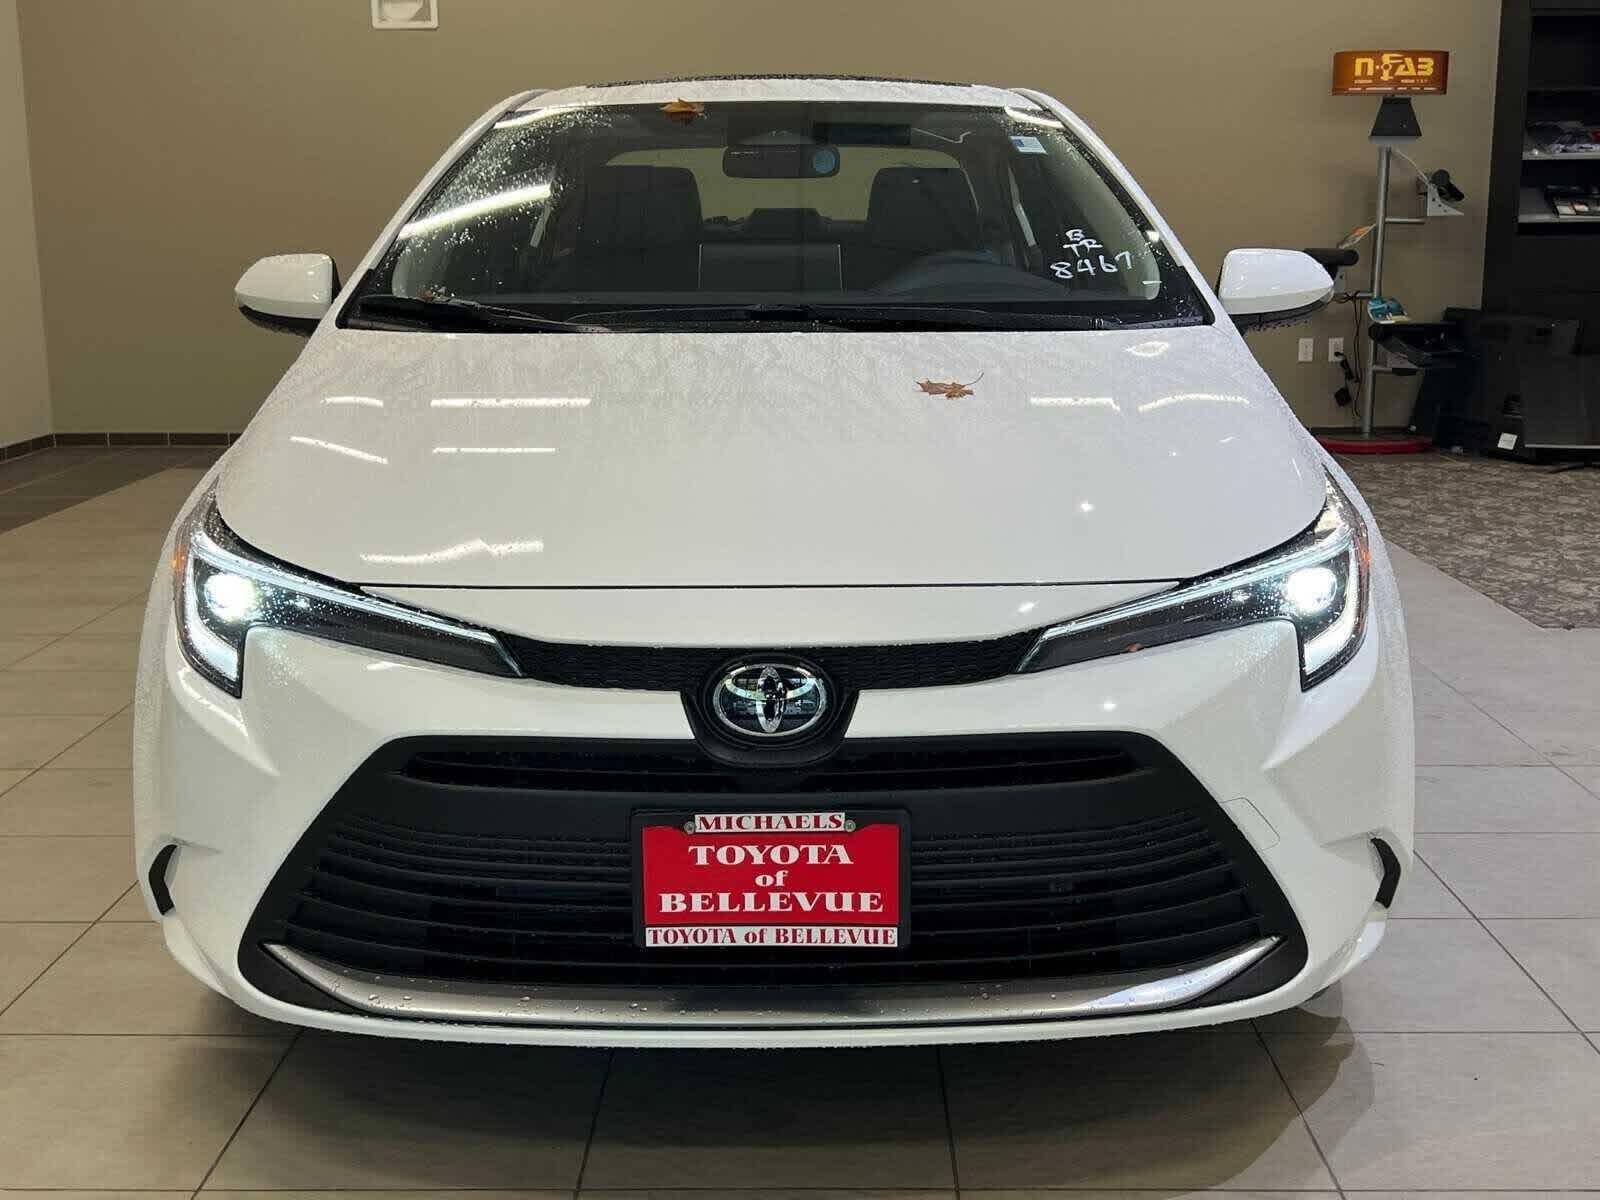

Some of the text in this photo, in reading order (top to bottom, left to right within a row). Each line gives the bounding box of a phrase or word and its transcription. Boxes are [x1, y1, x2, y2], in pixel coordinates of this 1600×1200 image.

[1050, 250, 1132, 279] 8467
[698, 814, 843, 830] MICHAELS
[688, 845, 854, 866] TOYOTA
[754, 870, 789, 887] of
[658, 892, 883, 912] BELLEVUE
[648, 928, 896, 945] TOYOTA of BELLEVUE
